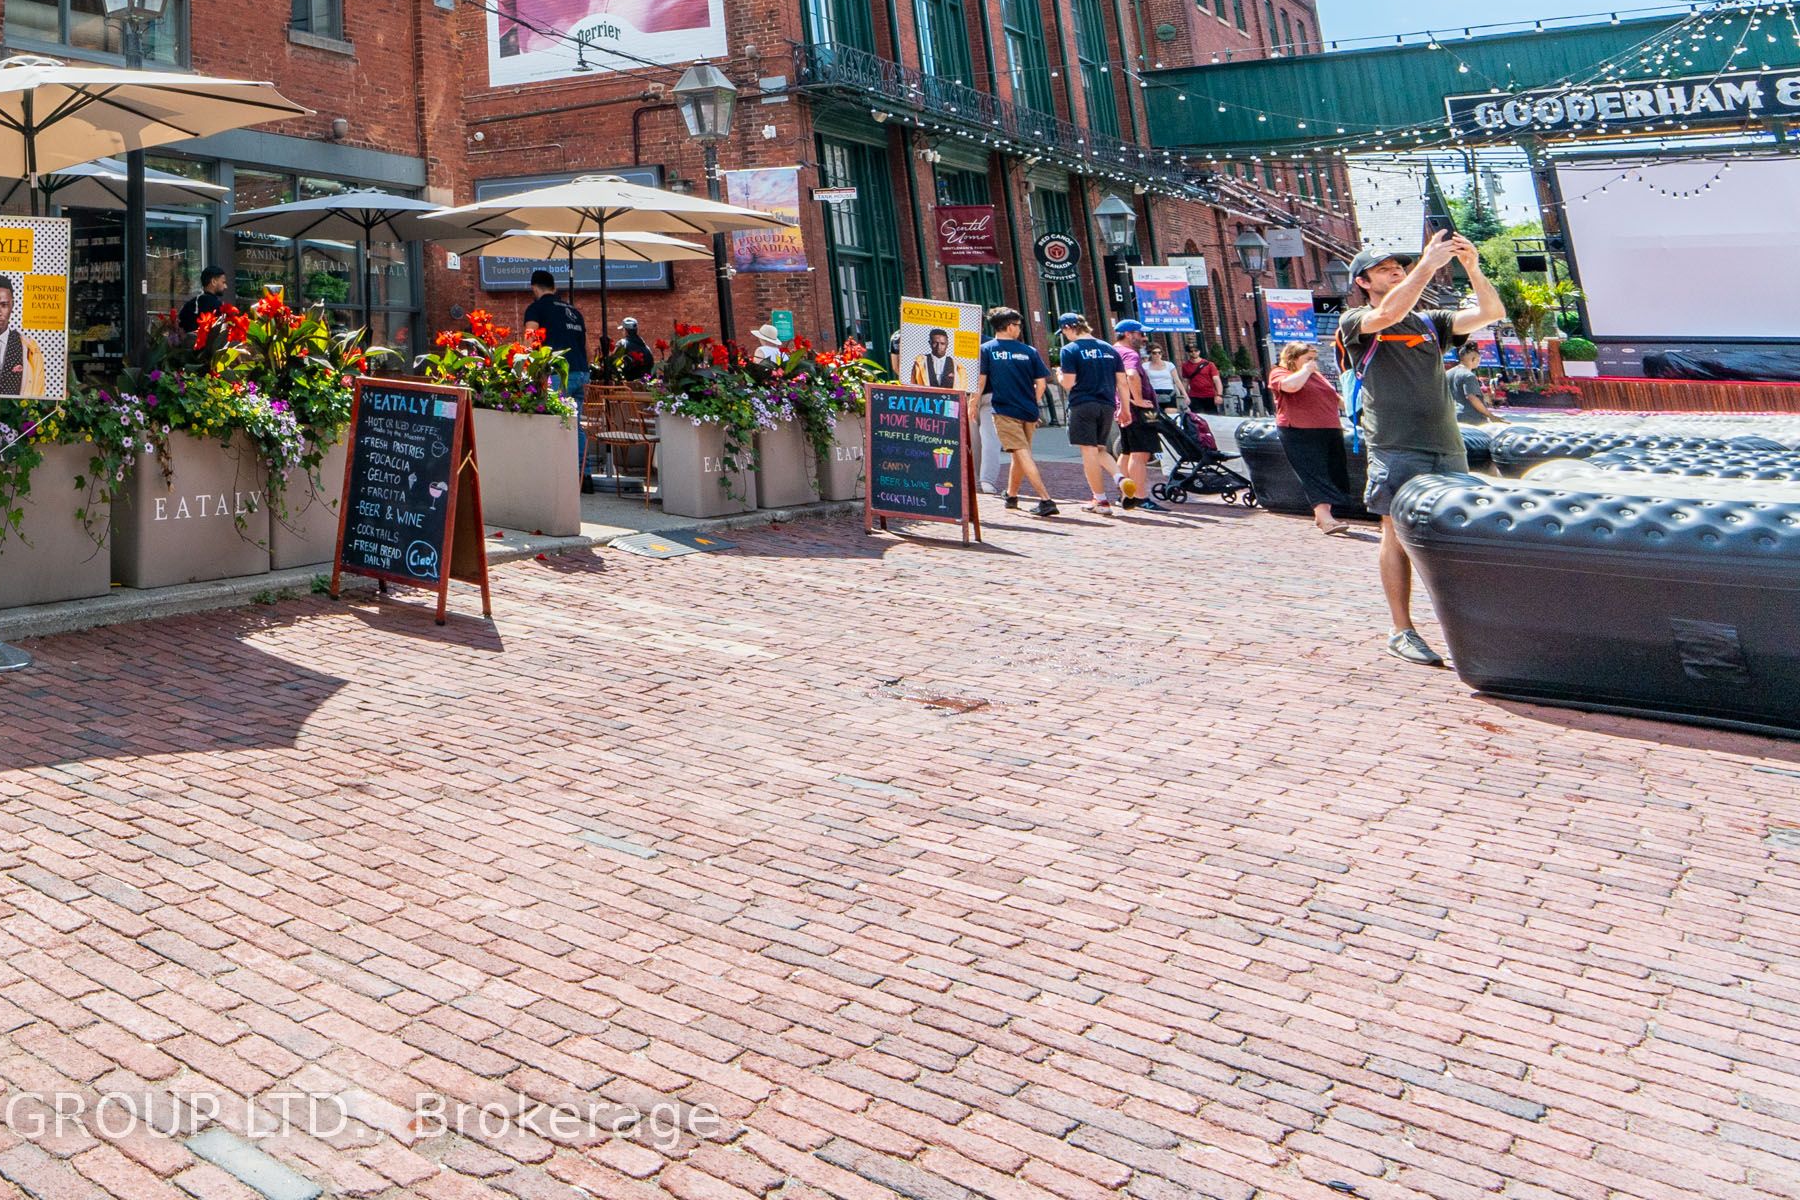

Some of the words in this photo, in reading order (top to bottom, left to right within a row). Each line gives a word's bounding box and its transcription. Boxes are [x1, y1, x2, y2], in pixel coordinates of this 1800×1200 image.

[1474, 80, 1764, 128] GOODERHAM
[941, 215, 990, 237] Gentil
[739, 234, 798, 245] PROUDLY
[1038, 235, 1050, 247] RED
[1050, 234, 1074, 246] CANOE
[737, 243, 799, 256] CANADIAN
[303, 255, 351, 273] EATALY
[370, 264, 409, 277] ATALY
[491, 266, 531, 275] Tuesdays
[549, 265, 570, 273] back
[1045, 261, 1072, 269] CANADA
[26, 284, 65, 293] UPSTAIRS
[32, 293, 59, 301] ABOVE
[31, 302, 61, 310] EATALY
[903, 307, 957, 320] GOTSTYLE
[374, 393, 428, 415] EATALY
[888, 395, 944, 414] EATALY
[412, 423, 441, 436] COFFEE
[915, 416, 950, 436] NIGHT
[913, 433, 942, 445] POPCORN
[392, 440, 425, 459] PASTRIES
[911, 480, 930, 490] WINE
[153, 490, 262, 521] EATALY
[385, 506, 393, 520] &
[396, 509, 425, 529] WINE
[379, 544, 402, 560] BREAD
[409, 550, 436, 568] Ciao!
